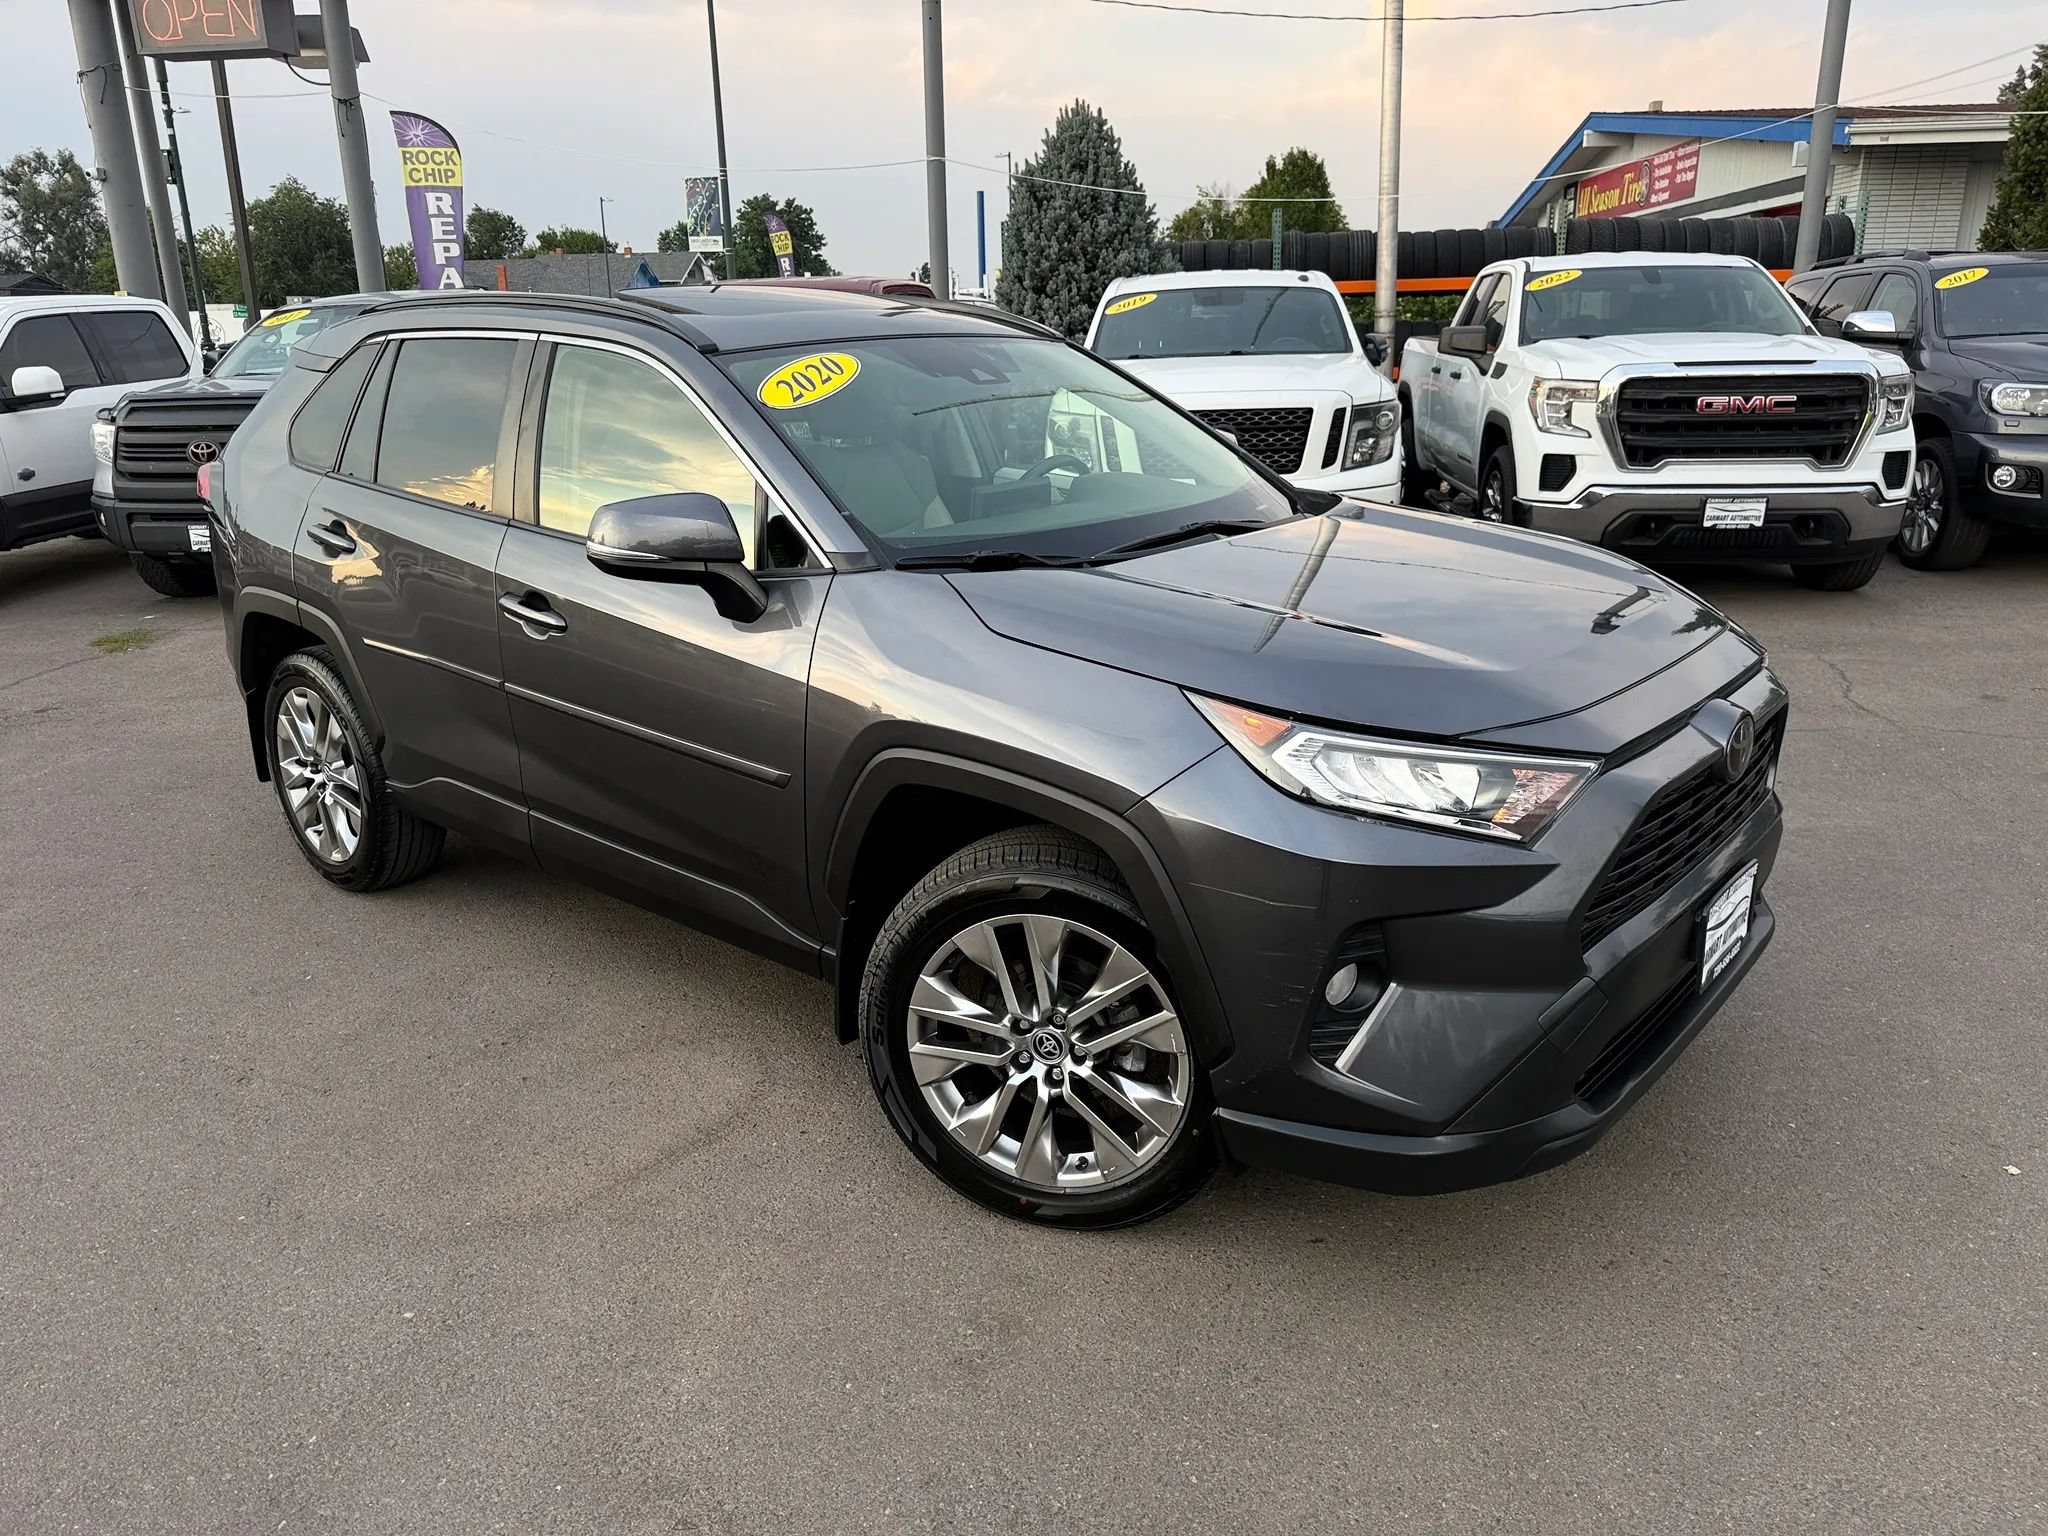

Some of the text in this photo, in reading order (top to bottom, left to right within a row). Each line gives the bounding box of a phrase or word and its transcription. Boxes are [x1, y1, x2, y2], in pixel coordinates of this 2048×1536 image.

[142, 0, 257, 41] OPEN
[402, 149, 458, 167] ROCK
[408, 167, 457, 184] CHIP
[1591, 185, 1621, 214] Season
[1536, 270, 1572, 290] 2022
[1944, 269, 1979, 288] 2017
[1111, 295, 1149, 314] 2019
[776, 355, 844, 403] 2020
[1696, 395, 1798, 415] GMC
[1730, 514, 1762, 522] AUTOMOTIVE
